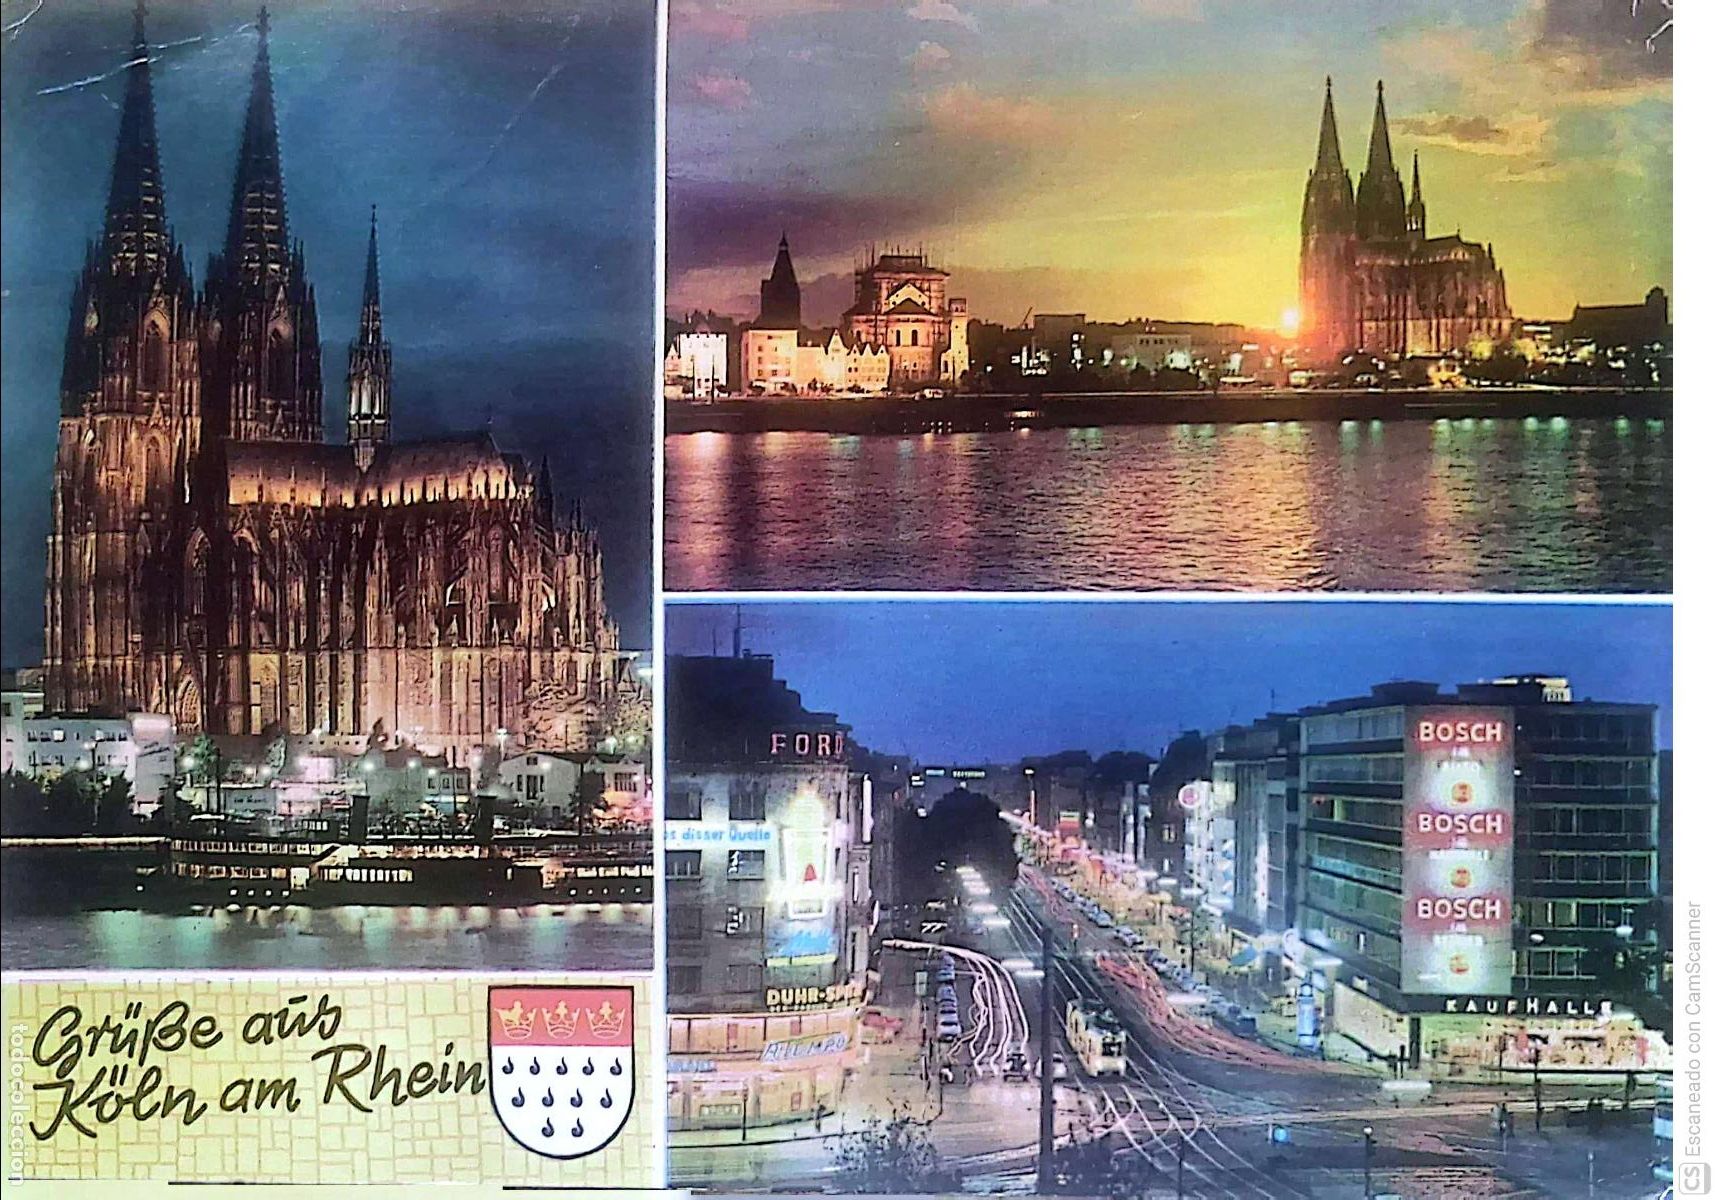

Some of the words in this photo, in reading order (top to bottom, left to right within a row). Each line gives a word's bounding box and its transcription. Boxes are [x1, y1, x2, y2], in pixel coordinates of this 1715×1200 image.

[1418, 721, 1503, 742] BOSCH
[770, 731, 844, 759] FORD
[1417, 812, 1504, 834] BOSCH
[1416, 897, 1502, 920] BOSCH
[1446, 997, 1614, 1014] KAUFHALLE
[32, 1000, 224, 1079] Grüße
[29, 1064, 209, 1141] Köln
[219, 1077, 301, 1113] am
[311, 1042, 486, 1113] Rhein
